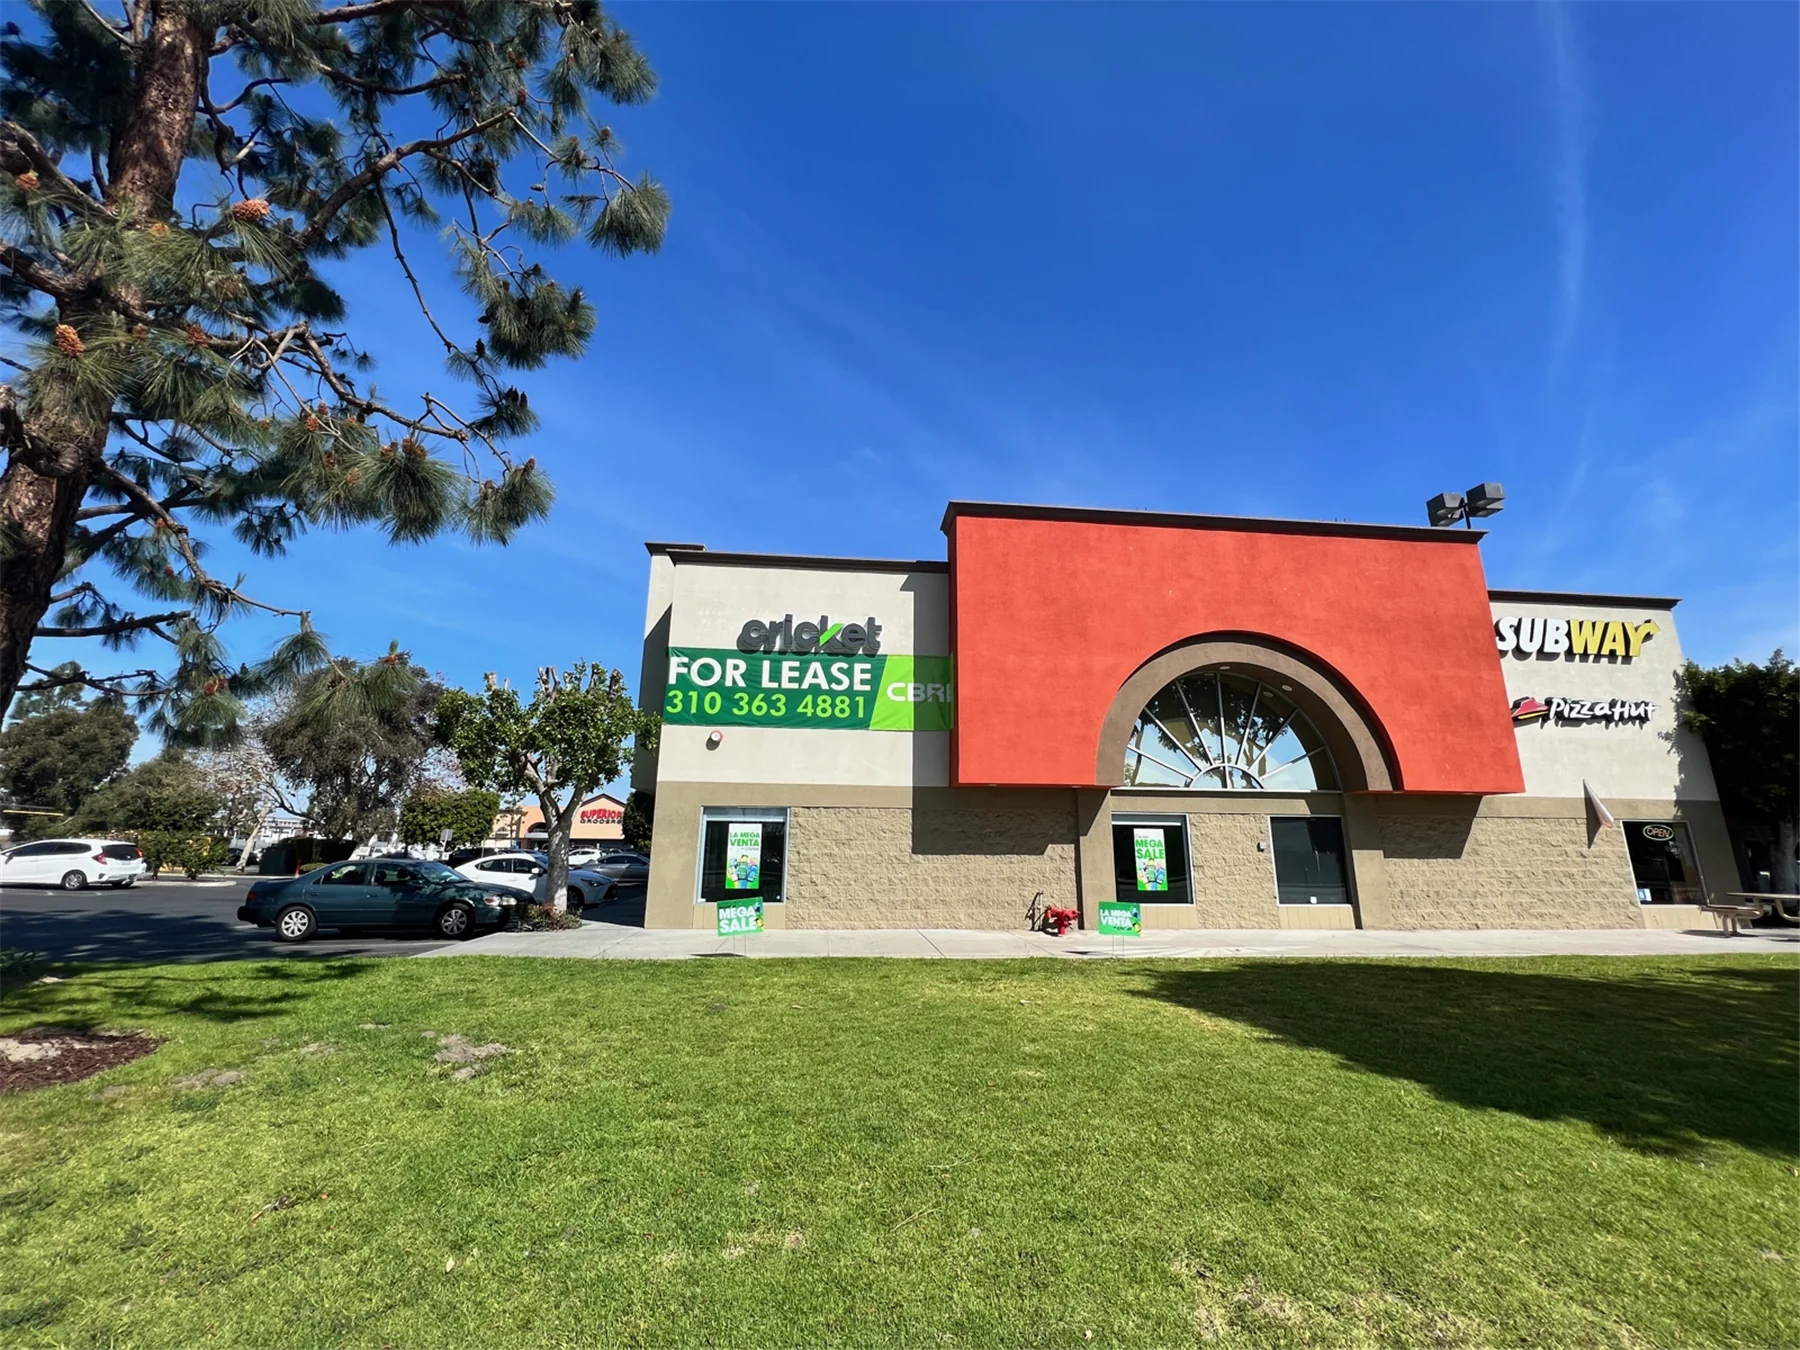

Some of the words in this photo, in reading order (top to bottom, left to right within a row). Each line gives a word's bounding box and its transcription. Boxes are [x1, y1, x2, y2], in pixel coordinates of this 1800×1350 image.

[742, 614, 882, 651] cricket
[1497, 616, 1661, 657] SUBWAY
[668, 656, 747, 688] FOR
[761, 660, 871, 691] LEASE
[665, 690, 722, 714] 310
[732, 692, 787, 716] 363
[796, 694, 864, 718] 4881
[580, 809, 623, 819] SUPERIOR
[1647, 827, 1670, 838] OPEN
[730, 839, 759, 847] VENTA
[1135, 839, 1163, 848] MEGA
[1136, 848, 1165, 859] SALE
[719, 906, 756, 919] MEGA
[1110, 910, 1132, 918] MEGA
[720, 917, 757, 933] SALE
[1101, 916, 1132, 927] VENTA
